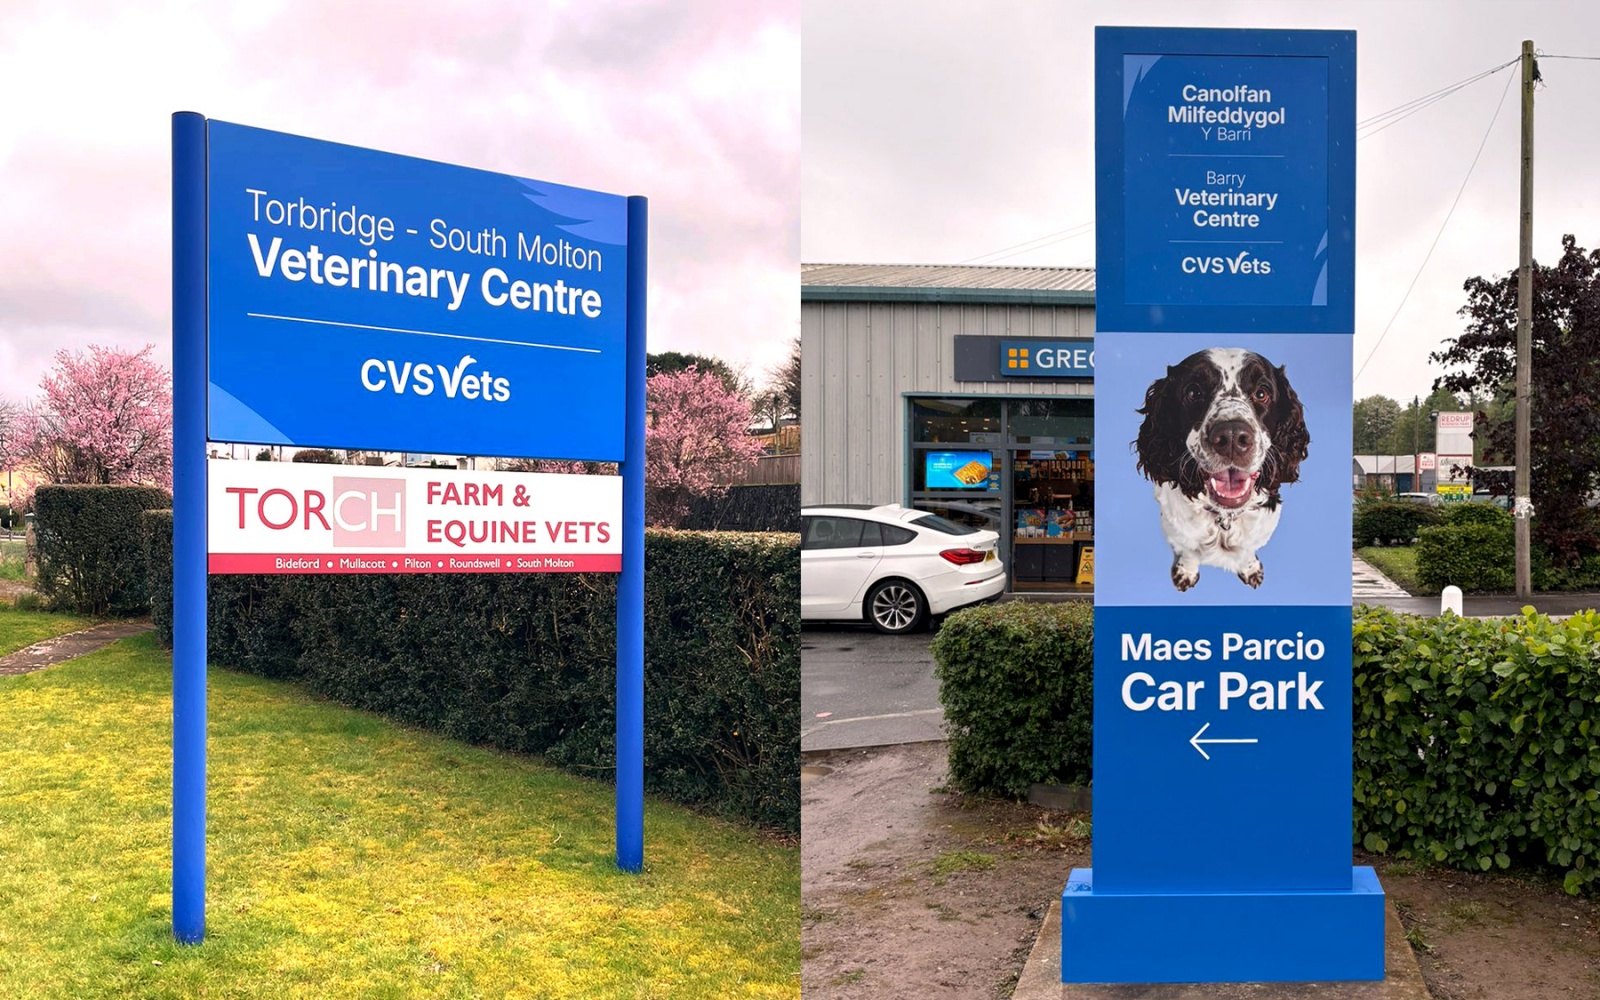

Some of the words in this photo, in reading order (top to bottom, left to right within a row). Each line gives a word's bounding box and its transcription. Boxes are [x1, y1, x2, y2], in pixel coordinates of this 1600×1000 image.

[1182, 84, 1271, 103] Canolfan
[1168, 106, 1285, 128] Milfeddygol
[1201, 127, 1212, 141] Y
[1217, 127, 1251, 141] Barri
[1206, 171, 1246, 188] Barry
[1175, 188, 1278, 210] Veterinary
[246, 188, 395, 245] Torbridge
[430, 219, 507, 258] South
[518, 232, 602, 272] Molton
[1193, 210, 1260, 227] Centre
[1181, 257, 1224, 274] CVS
[1225, 251, 1271, 274] Vets
[247, 233, 470, 311] Veterinary
[481, 267, 602, 318] Centre
[361, 358, 435, 396] CVS
[436, 355, 511, 402] Vets
[427, 481, 503, 506] FARM
[512, 484, 531, 507] &
[226, 487, 402, 533] TORCH
[427, 519, 536, 547] EQUINE
[544, 521, 610, 544] VETS
[275, 557, 320, 569] Bideford
[339, 557, 386, 569] Mullacott
[404, 557, 432, 569] Pilton
[449, 557, 501, 569] Roundswell
[517, 557, 542, 569] South
[544, 557, 574, 569] Molton
[1121, 633, 1212, 661] Maes
[1222, 631, 1325, 661] Parcio
[1121, 671, 1205, 711] Car
[1219, 671, 1325, 710] Park
